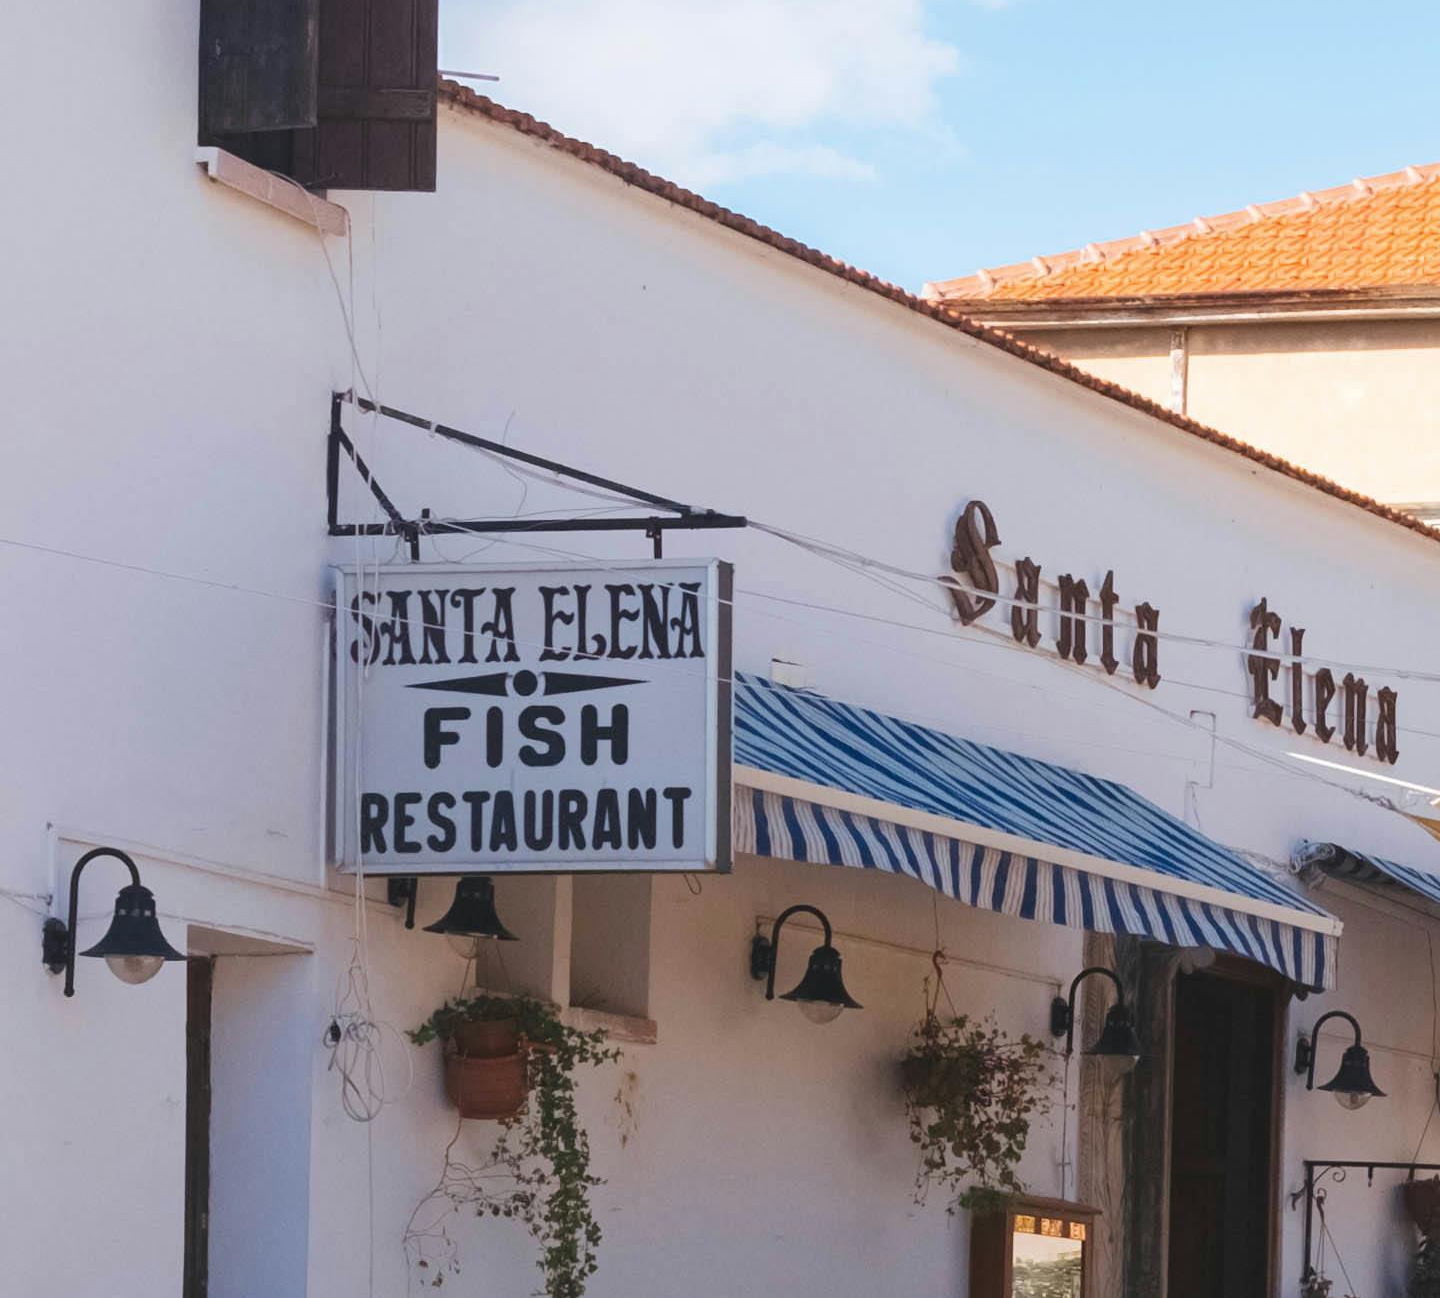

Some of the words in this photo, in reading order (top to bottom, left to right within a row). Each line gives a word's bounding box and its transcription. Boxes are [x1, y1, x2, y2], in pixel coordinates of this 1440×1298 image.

[350, 588, 521, 666] SANTA
[539, 582, 705, 661] ELENA
[937, 499, 1161, 689] Santa
[1247, 597, 1399, 765] Elena
[423, 704, 629, 768] FISH
[361, 787, 692, 854] RESTAURANT
